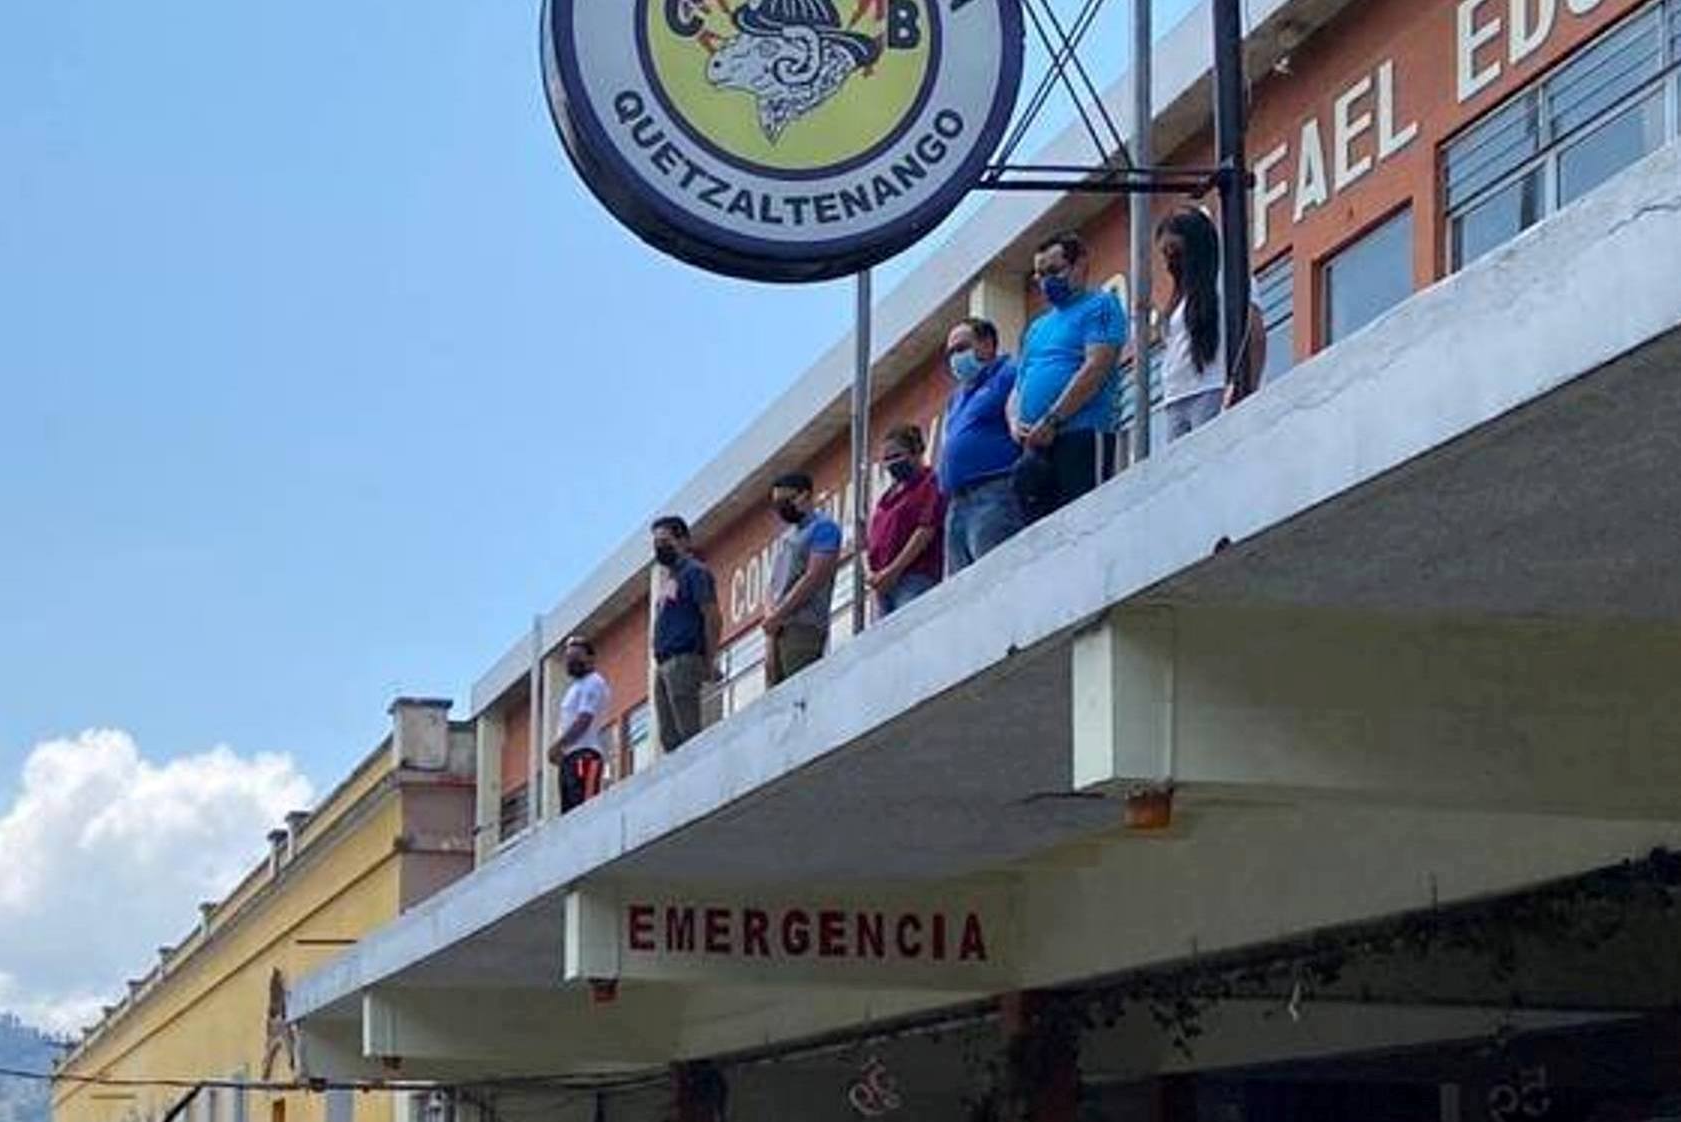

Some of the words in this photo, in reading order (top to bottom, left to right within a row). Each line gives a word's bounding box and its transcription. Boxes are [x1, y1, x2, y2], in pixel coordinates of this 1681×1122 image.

[613, 89, 965, 227] QUETZALTENANGO
[1253, 59, 1418, 250] FAEL
[1456, 0, 1599, 104] ED
[627, 905, 988, 961] EMERGENCIA
